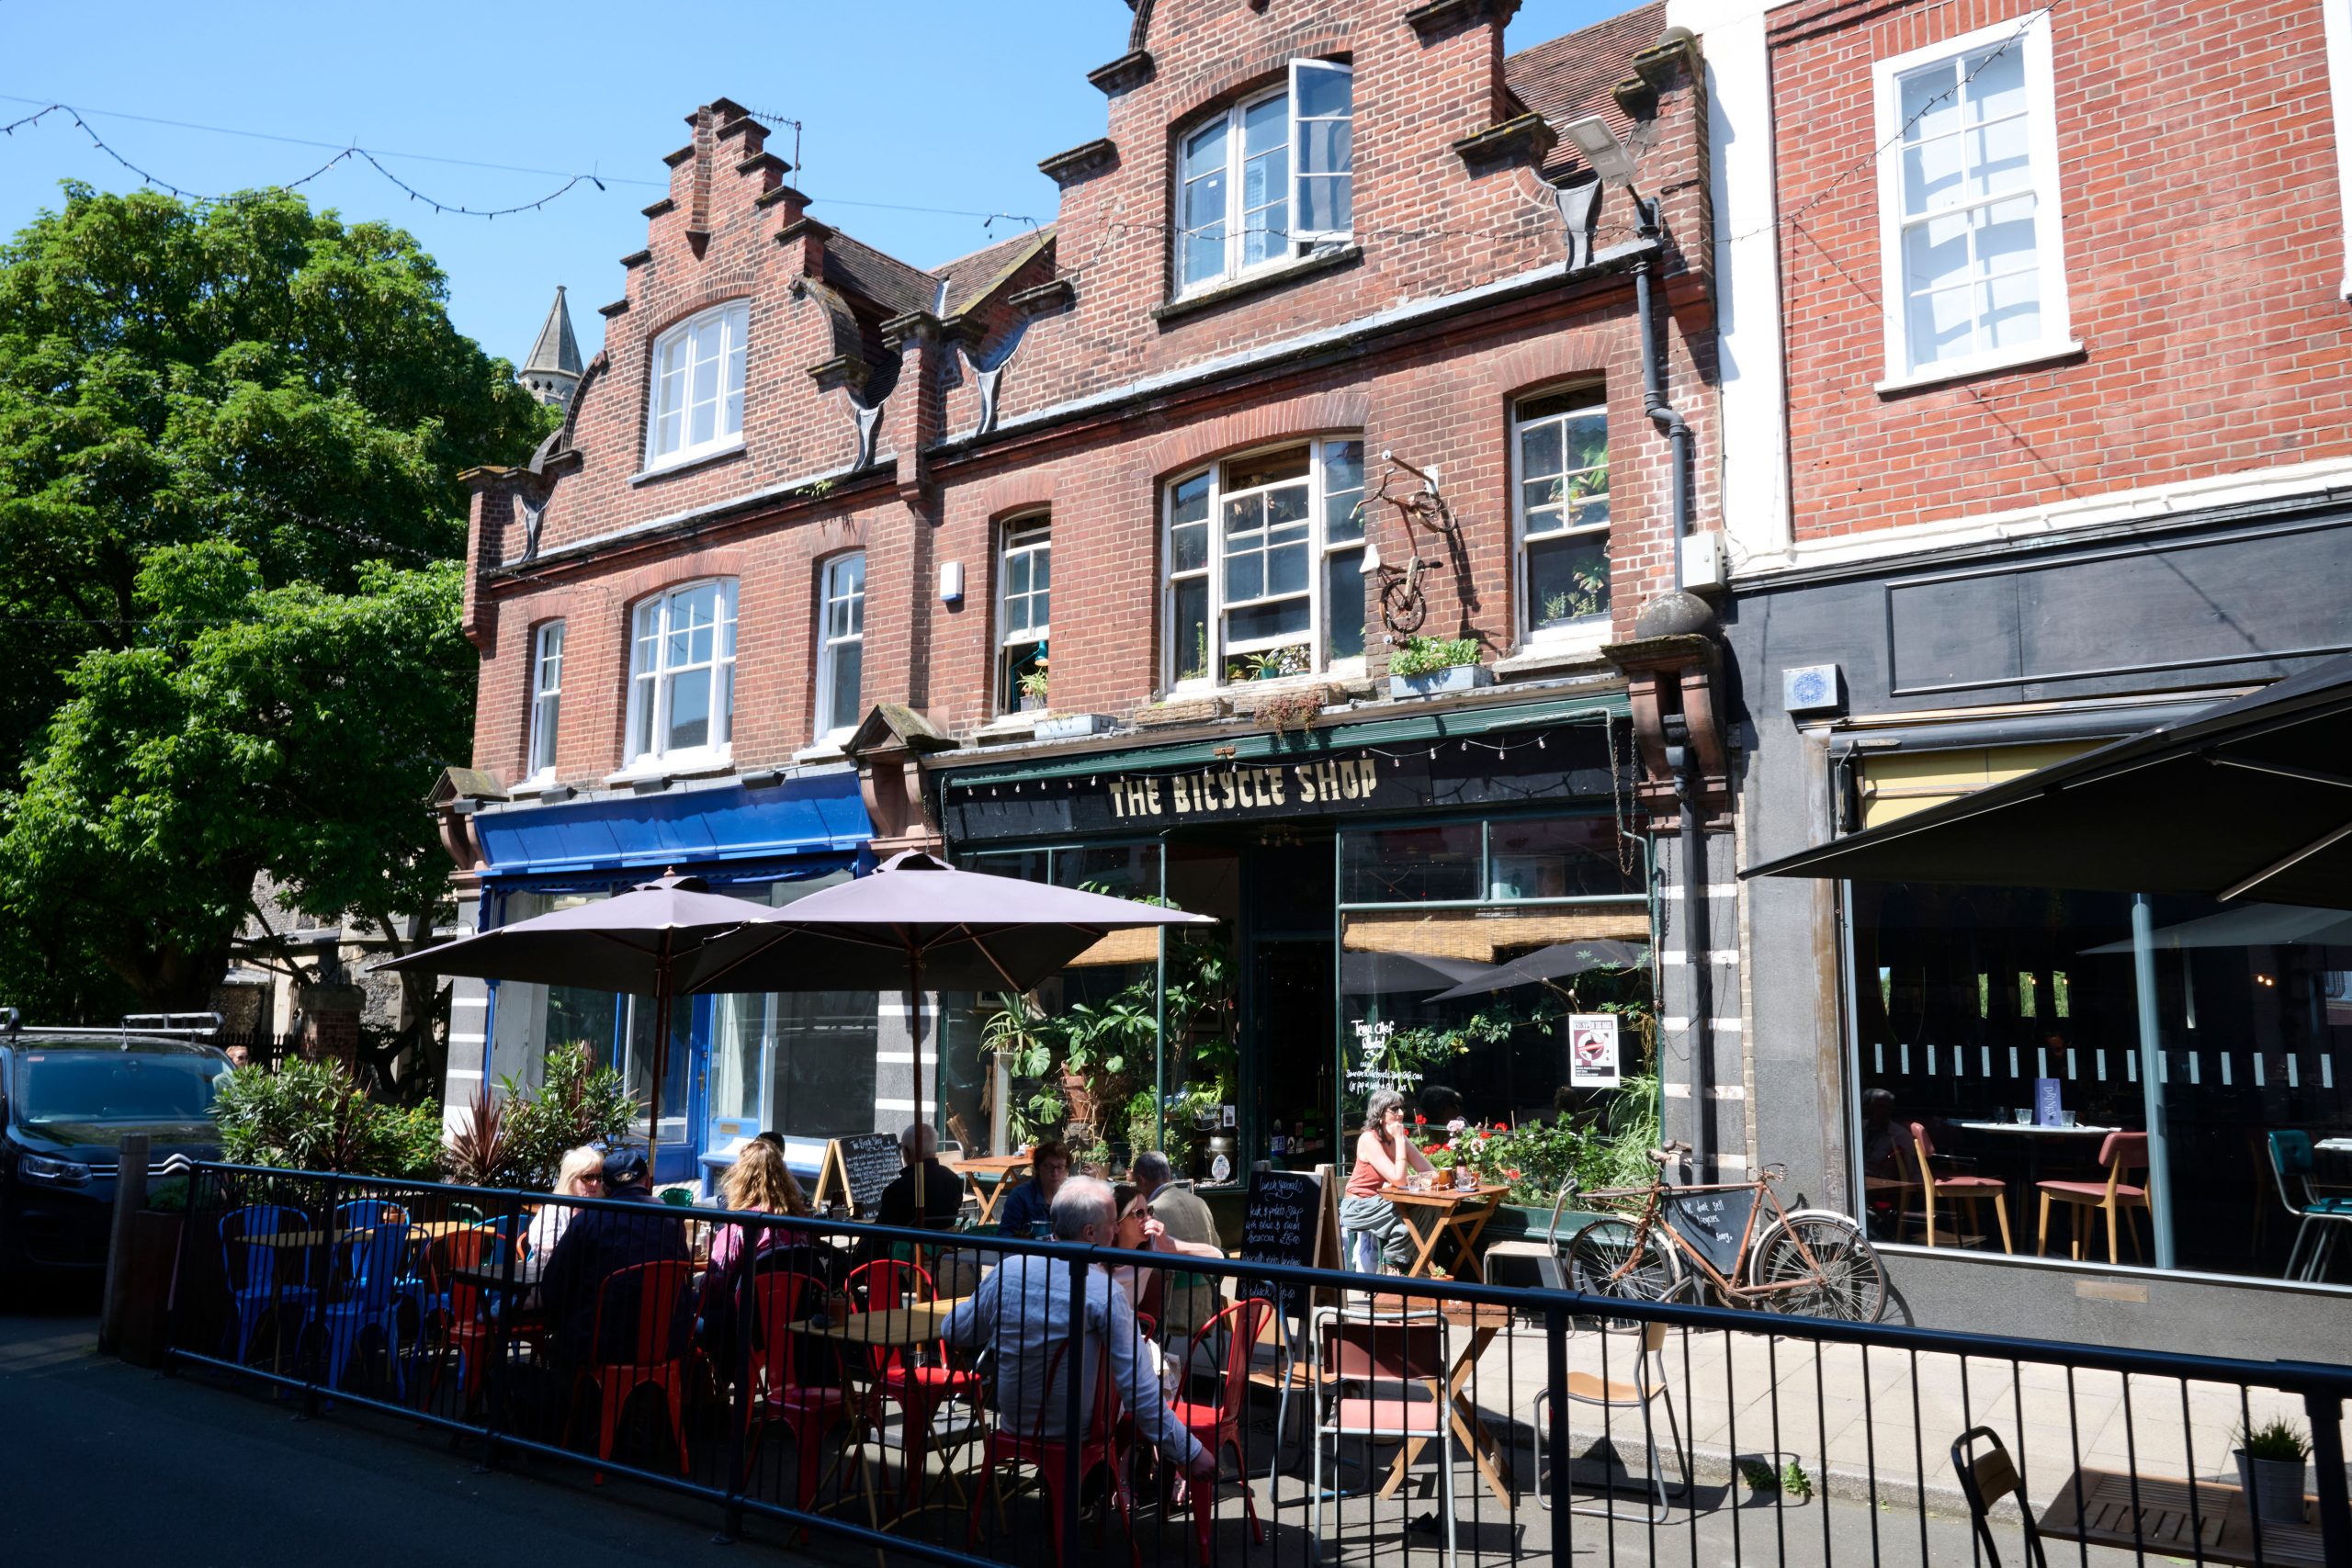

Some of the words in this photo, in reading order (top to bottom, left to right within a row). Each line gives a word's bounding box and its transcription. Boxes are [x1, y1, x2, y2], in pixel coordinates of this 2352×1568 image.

[1109, 779, 1161, 818] THE
[1171, 767, 1286, 813] BICYCLE
[1297, 759, 1377, 803] SHOP
[1374, 1021, 1395, 1037] Chef
[2043, 1086, 2057, 1116] DRINKS
